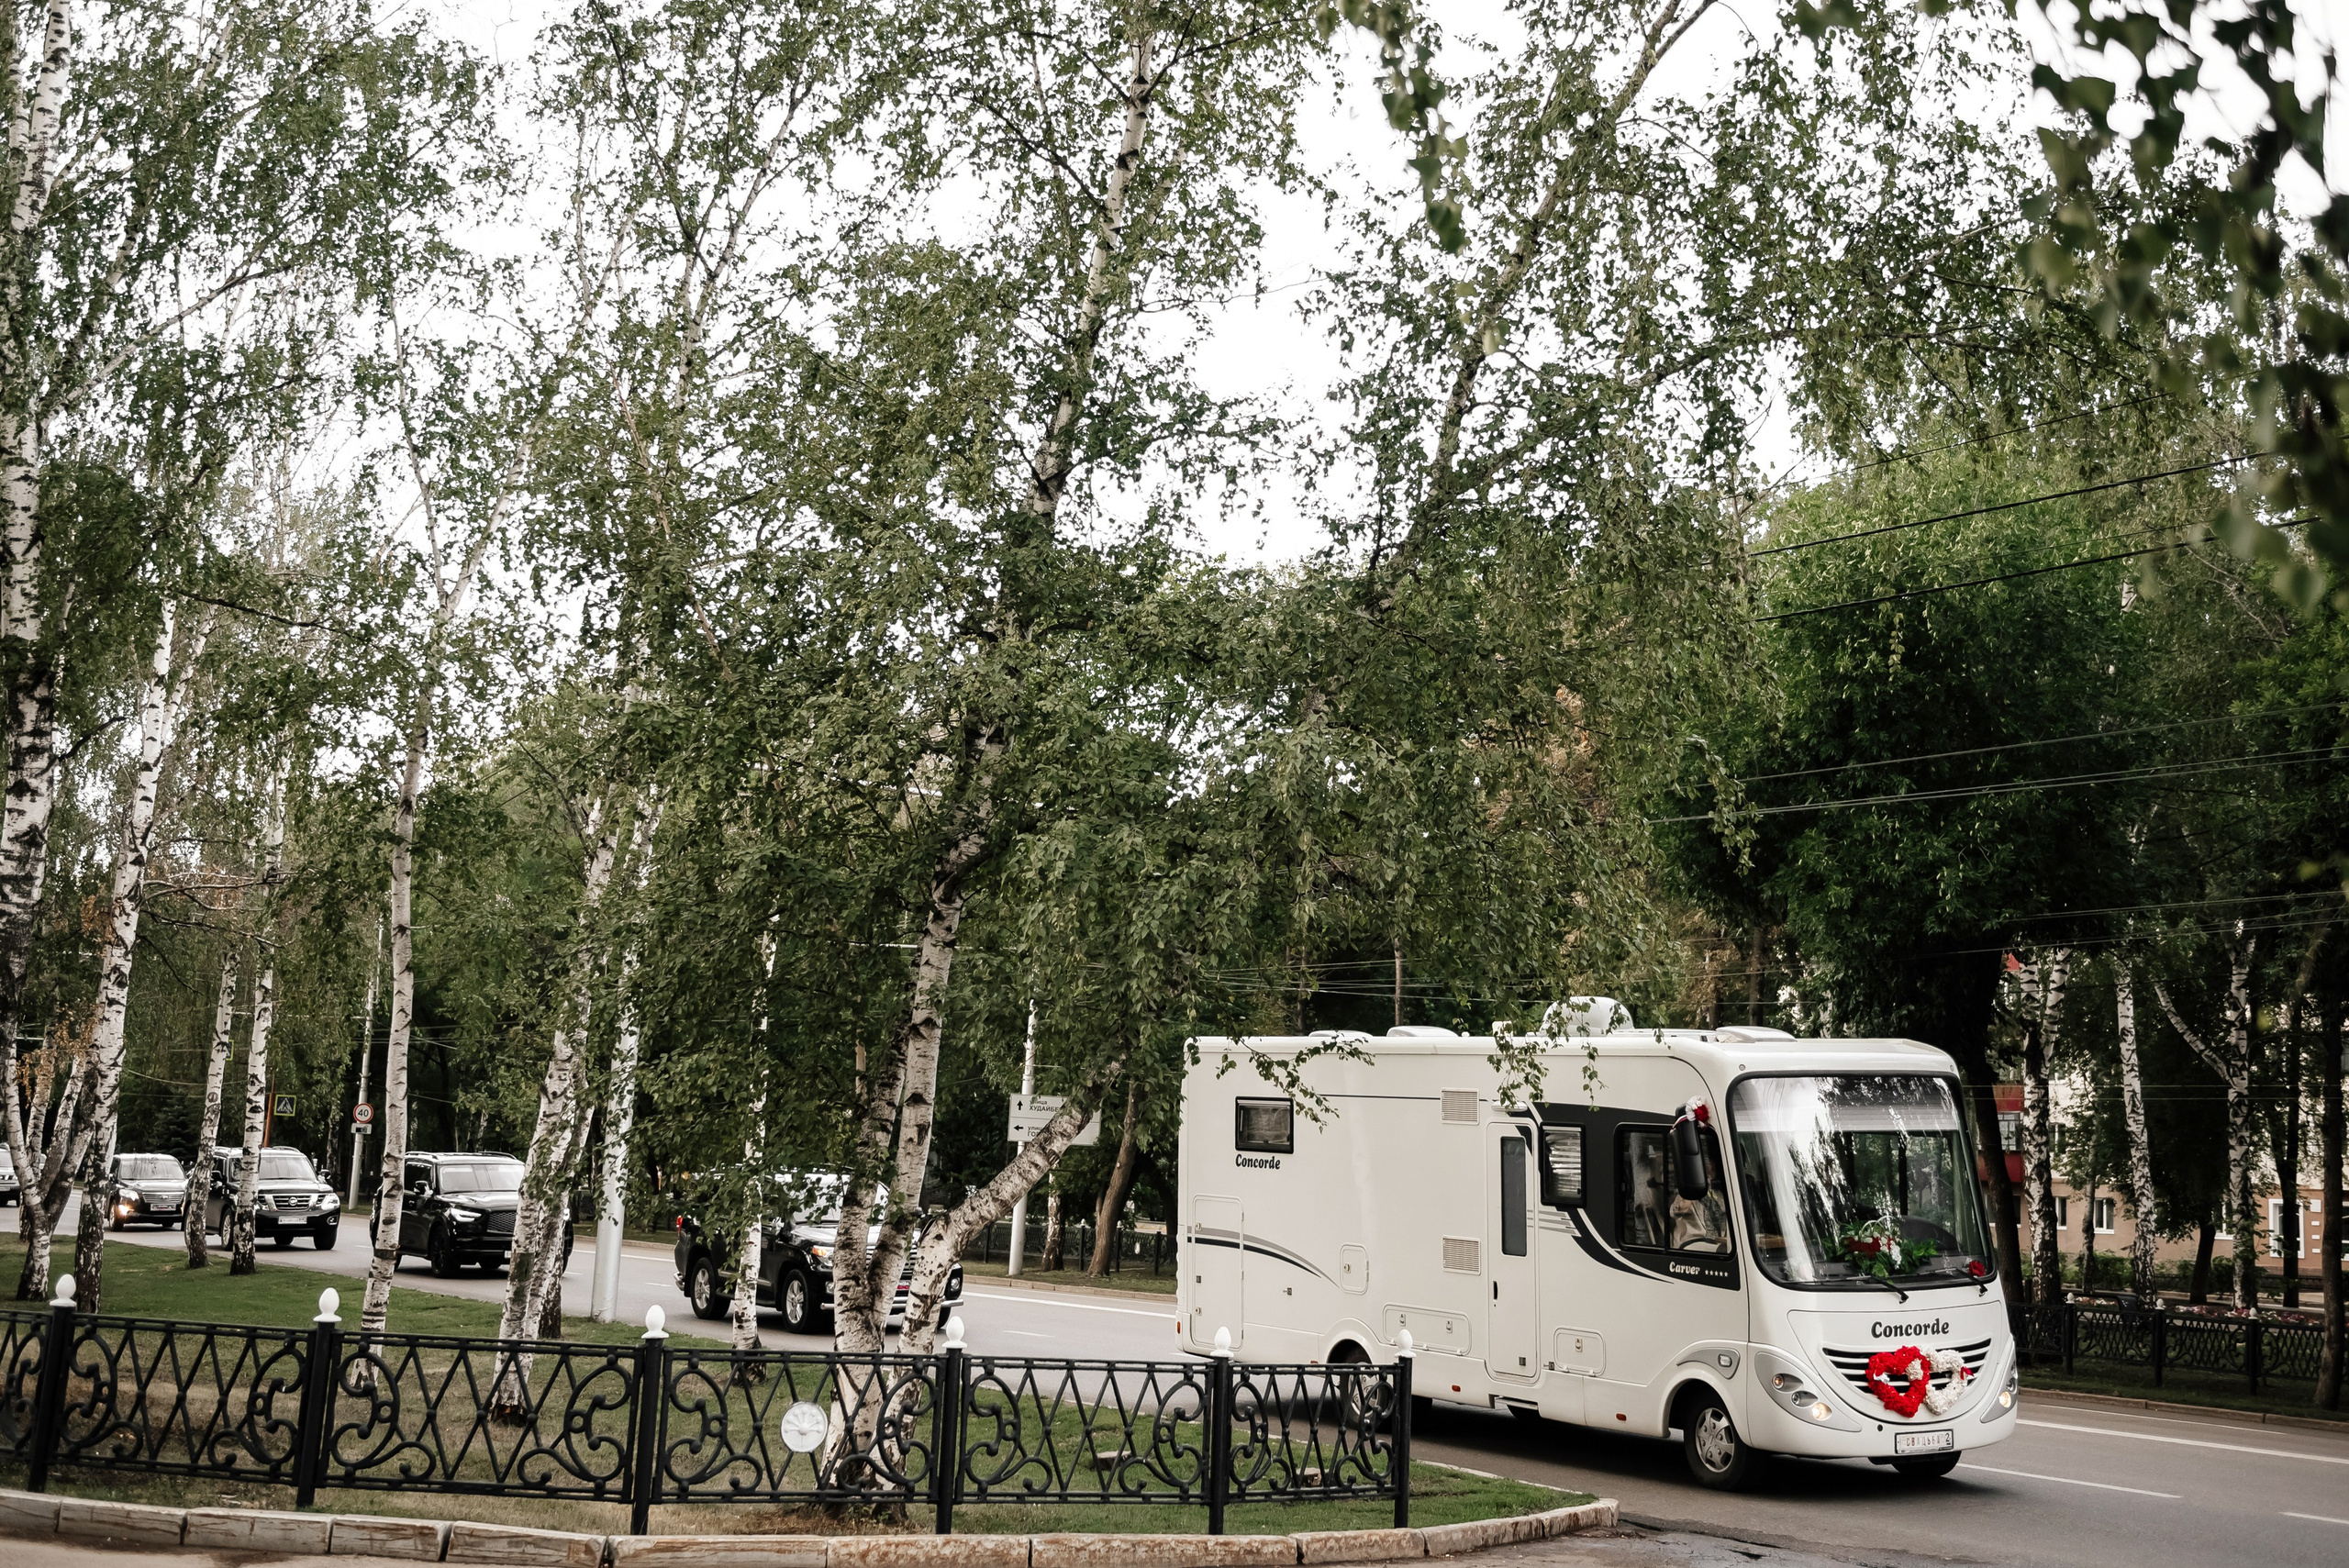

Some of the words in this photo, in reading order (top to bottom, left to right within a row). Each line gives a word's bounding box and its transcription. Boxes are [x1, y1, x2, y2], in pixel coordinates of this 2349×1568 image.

[358, 1109, 369, 1118] 40
[1235, 1153, 1281, 1170] Concorde
[1669, 1261, 1700, 1274] Carver
[1871, 1318, 1950, 1339] Concorde
